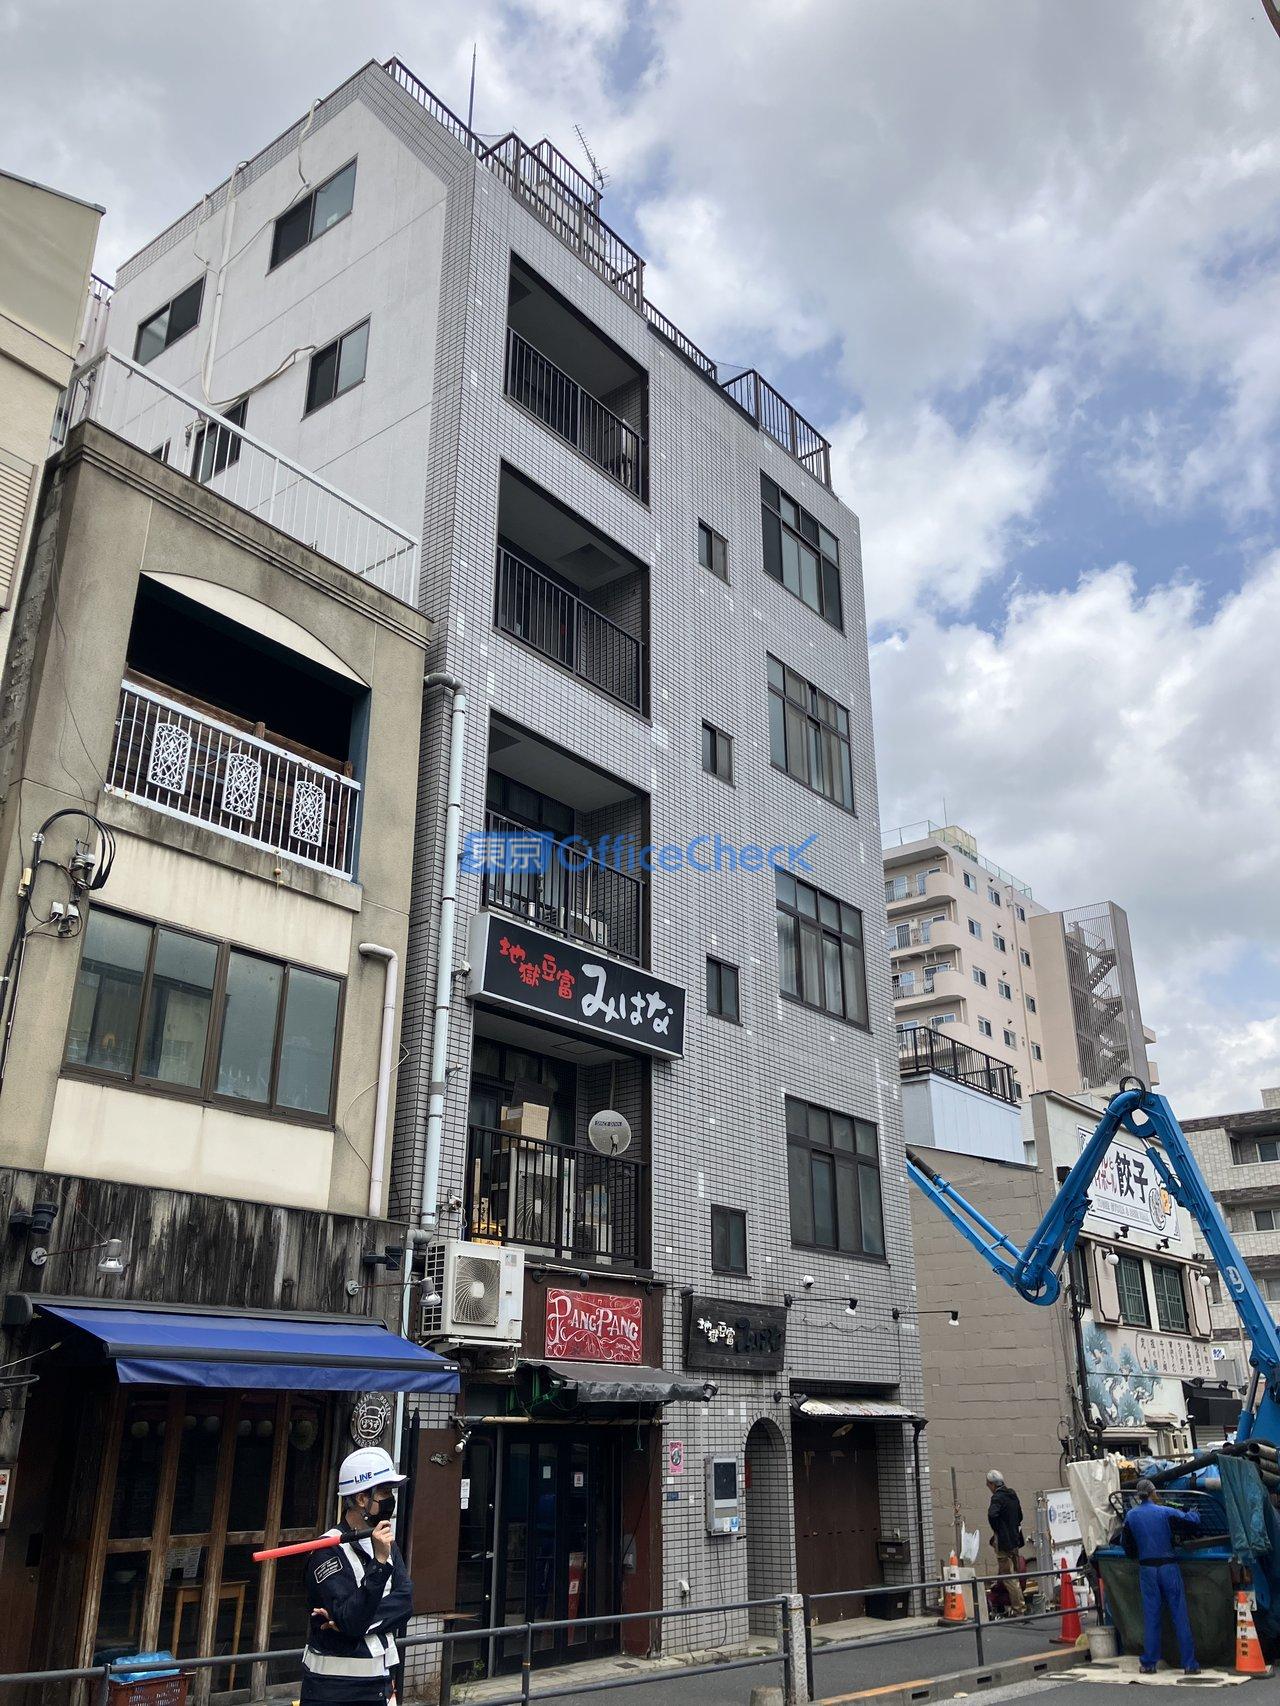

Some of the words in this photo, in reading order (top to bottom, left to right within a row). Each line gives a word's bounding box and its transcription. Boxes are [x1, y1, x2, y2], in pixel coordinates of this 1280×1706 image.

[499, 937, 576, 999] 地獄豆富
[581, 963, 674, 1036] みはな
[1115, 1150, 1149, 1204] 餃子
